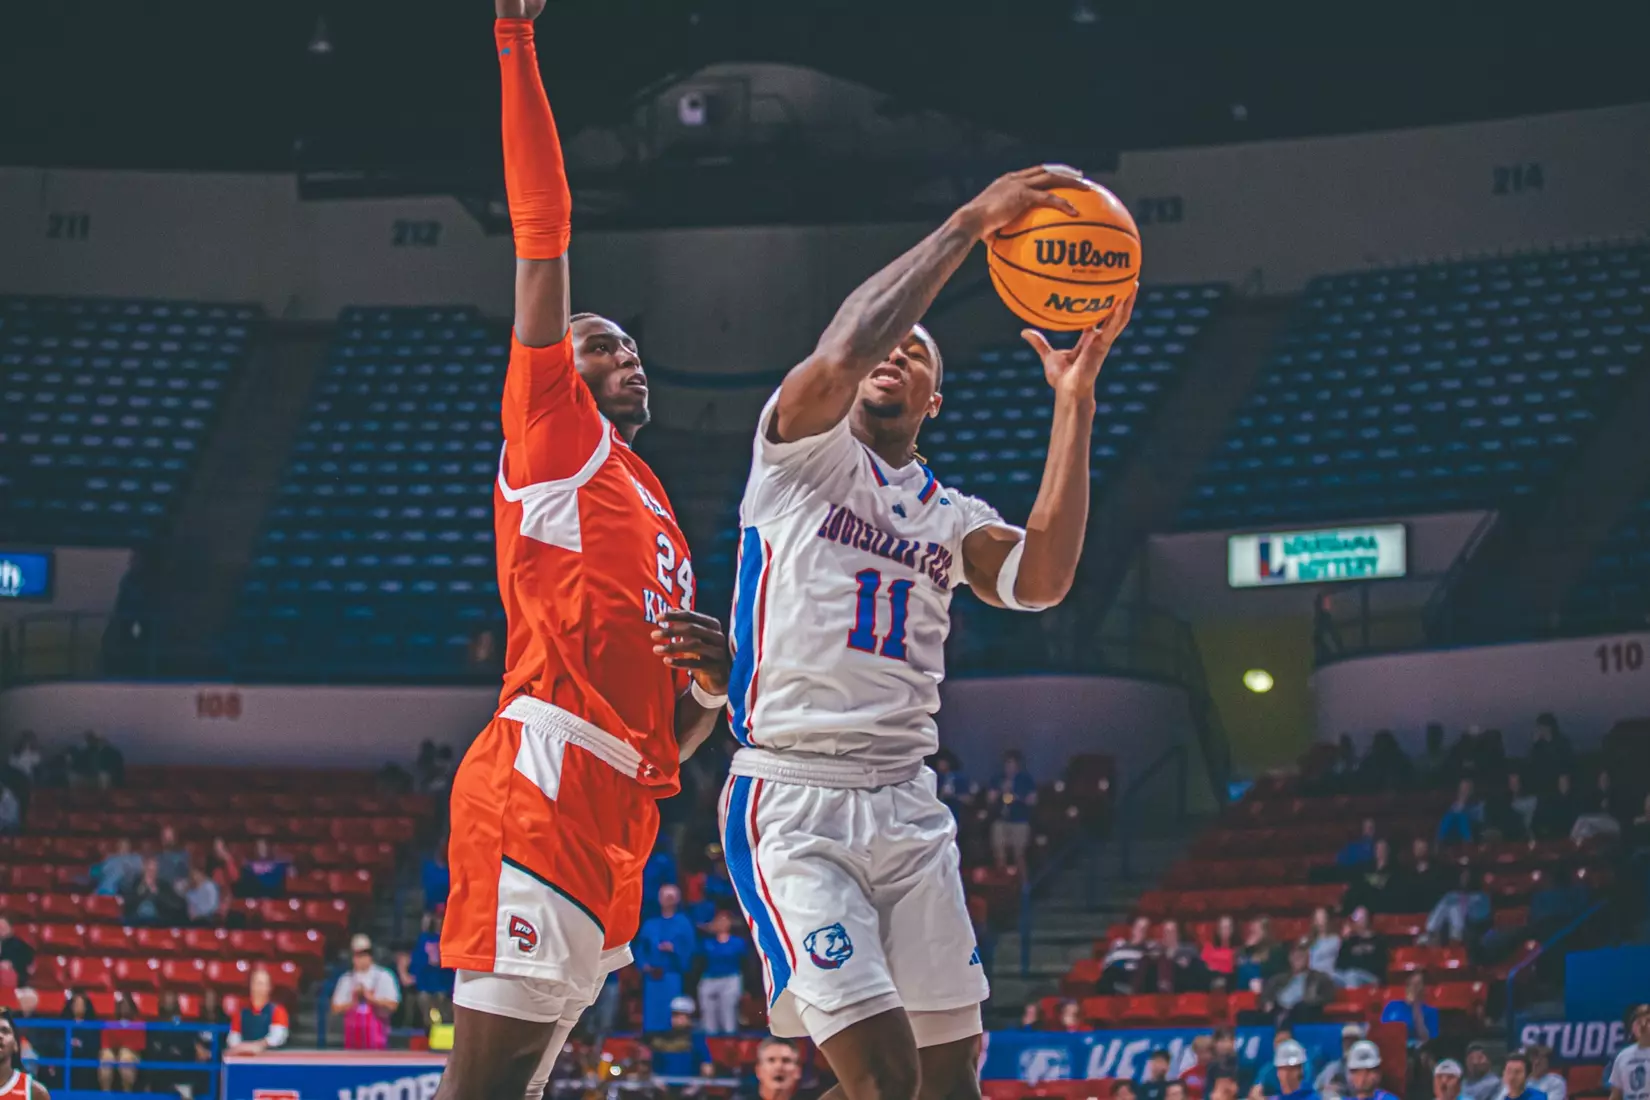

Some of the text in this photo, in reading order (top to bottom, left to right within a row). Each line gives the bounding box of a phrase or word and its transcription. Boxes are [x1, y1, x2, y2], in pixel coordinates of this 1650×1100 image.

[1034, 239, 1131, 270] Wilson
[1044, 292, 1116, 314] NCAA
[656, 532, 694, 612] 24
[846, 567, 916, 662] 11
[1594, 641, 1645, 674] 110
